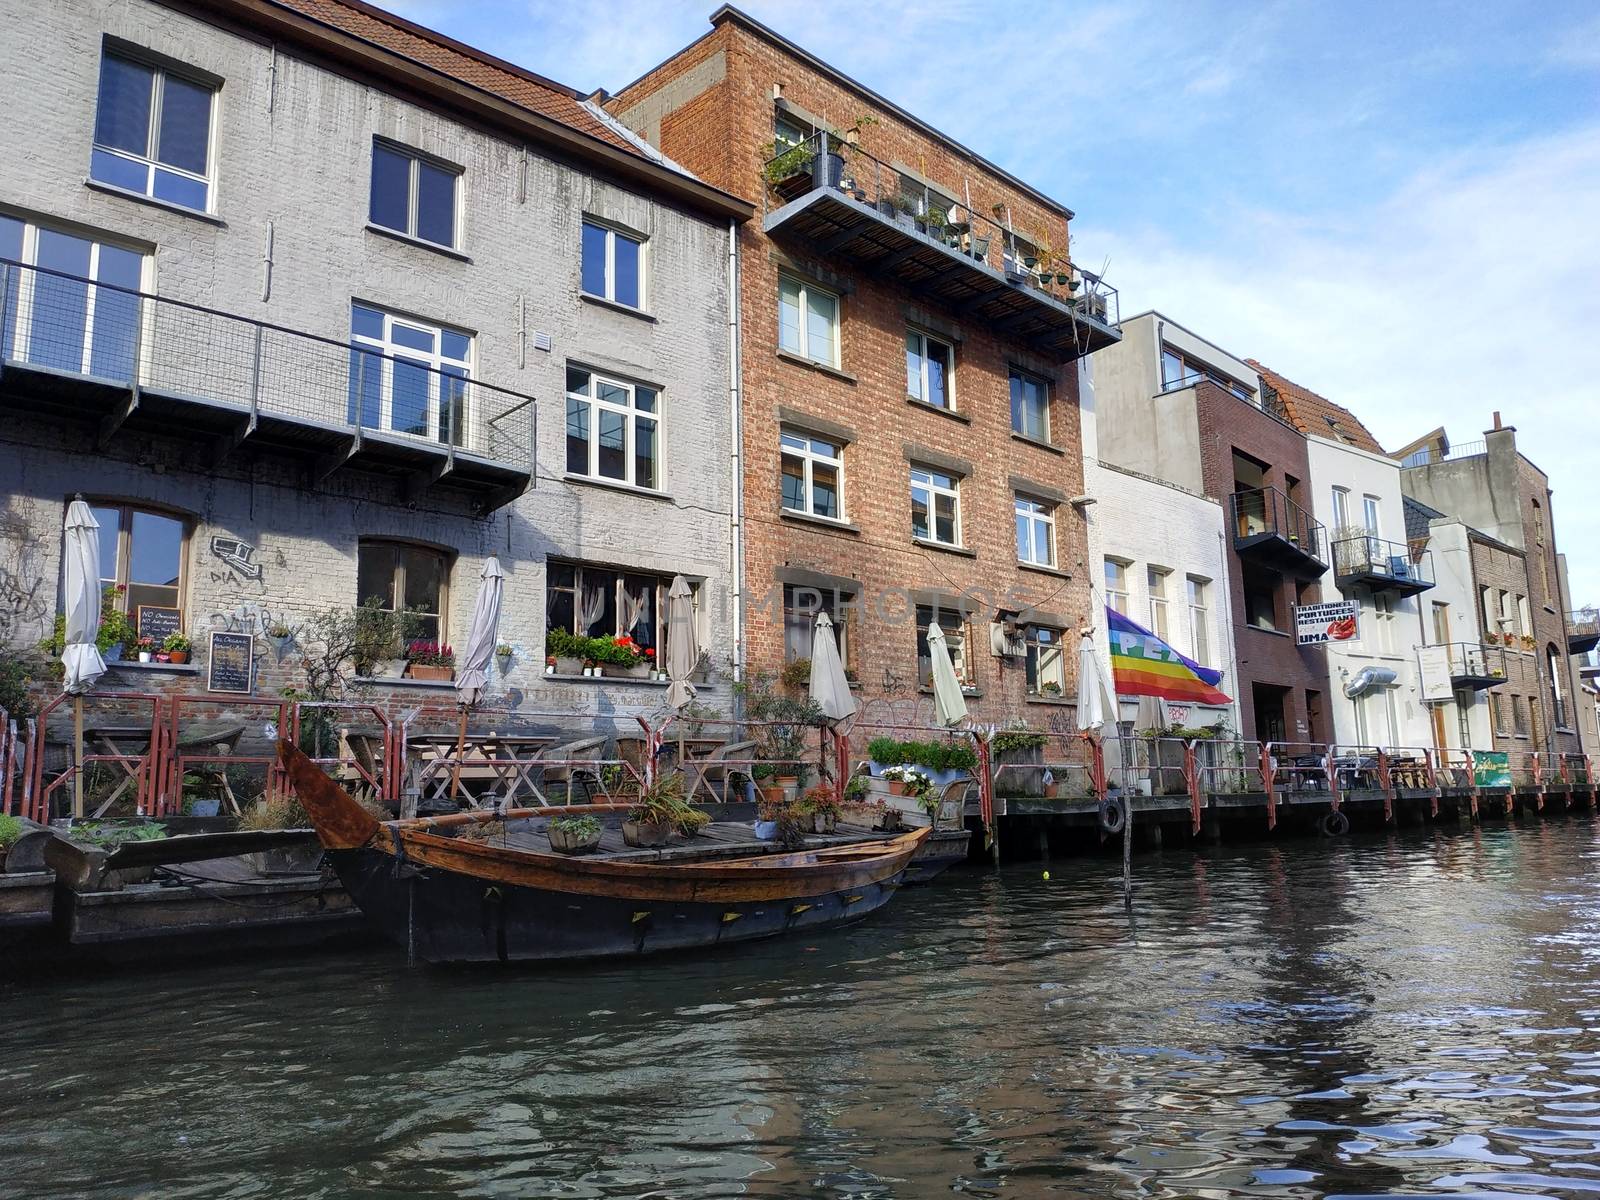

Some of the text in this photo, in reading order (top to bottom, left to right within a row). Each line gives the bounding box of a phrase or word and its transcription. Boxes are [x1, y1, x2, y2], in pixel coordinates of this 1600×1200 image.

[211, 571, 241, 586] DIA
[1298, 602, 1352, 612] TRADITIONEEL
[1298, 614, 1354, 626] RESTAURANT
[1299, 632, 1329, 644] UMA
